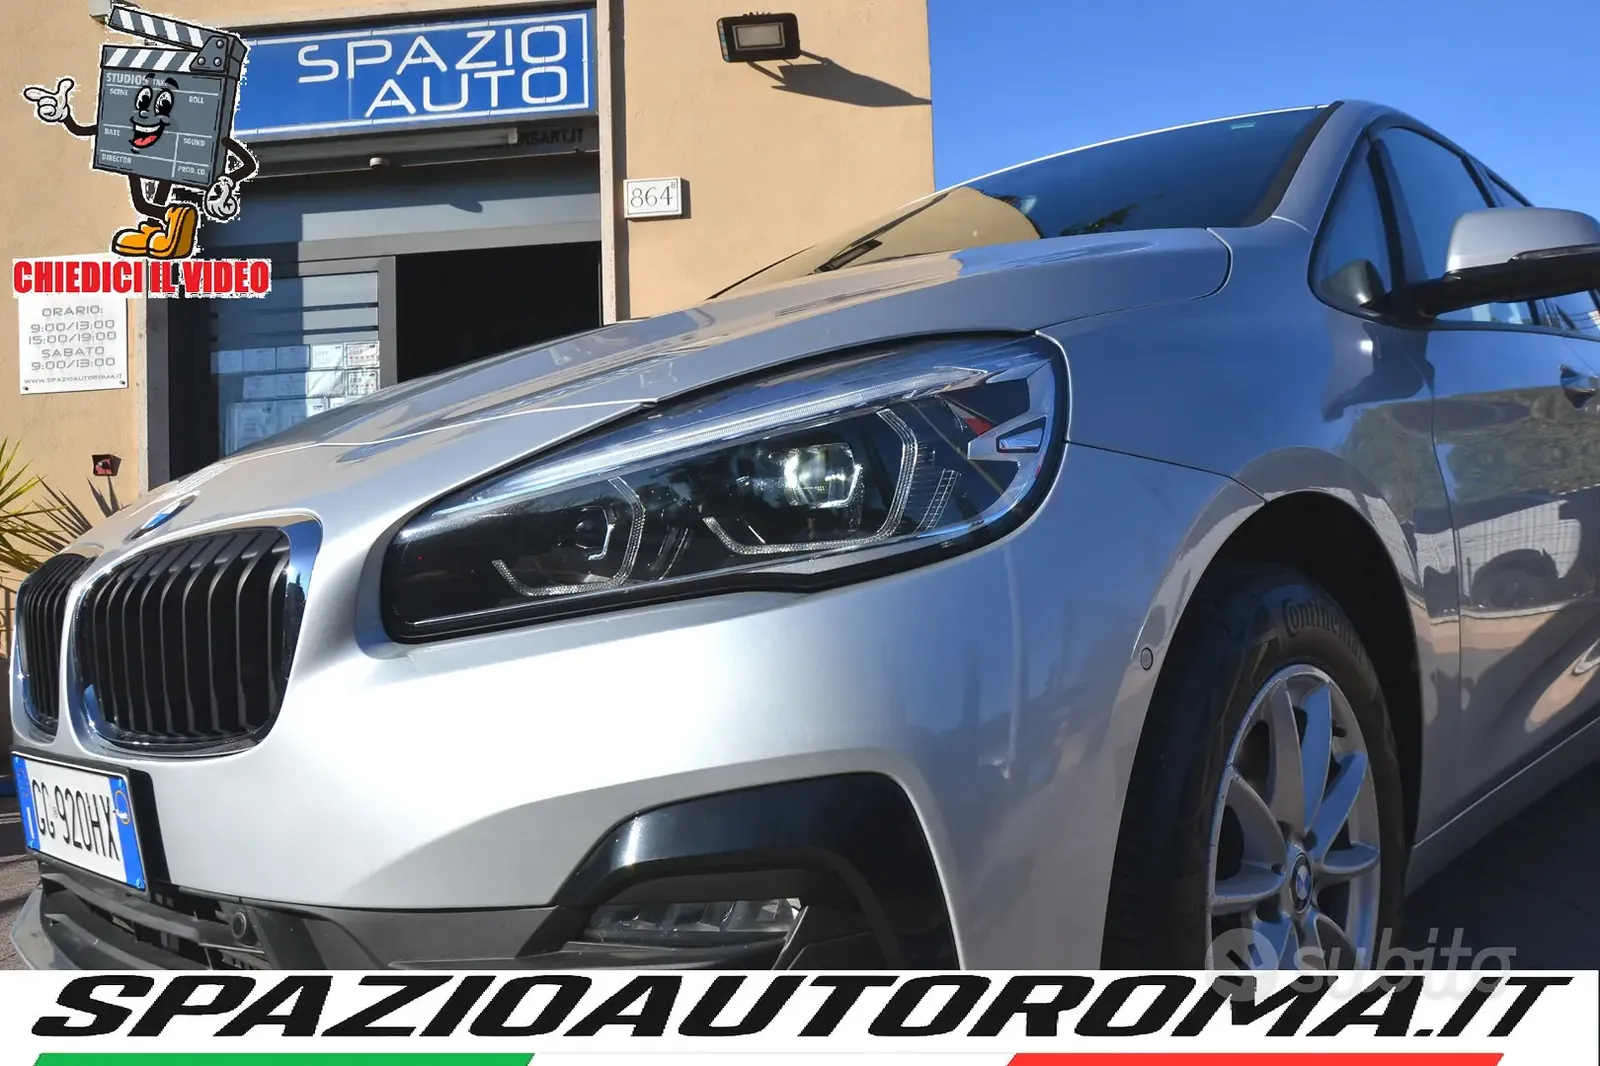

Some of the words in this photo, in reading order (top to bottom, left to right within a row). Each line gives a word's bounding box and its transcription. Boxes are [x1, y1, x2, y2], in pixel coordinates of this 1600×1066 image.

[298, 25, 567, 83] SPAZIO
[365, 66, 567, 117] AUTO
[630, 185, 673, 208] 864
[42, 305, 103, 317] ORARIO:
[30, 319, 115, 333] 9:00/13:00
[28, 331, 117, 345] 15:00/19:00
[41, 346, 105, 358] SABATO
[31, 357, 116, 371] 9:00/13:00
[54, 785, 120, 861] 920HX
